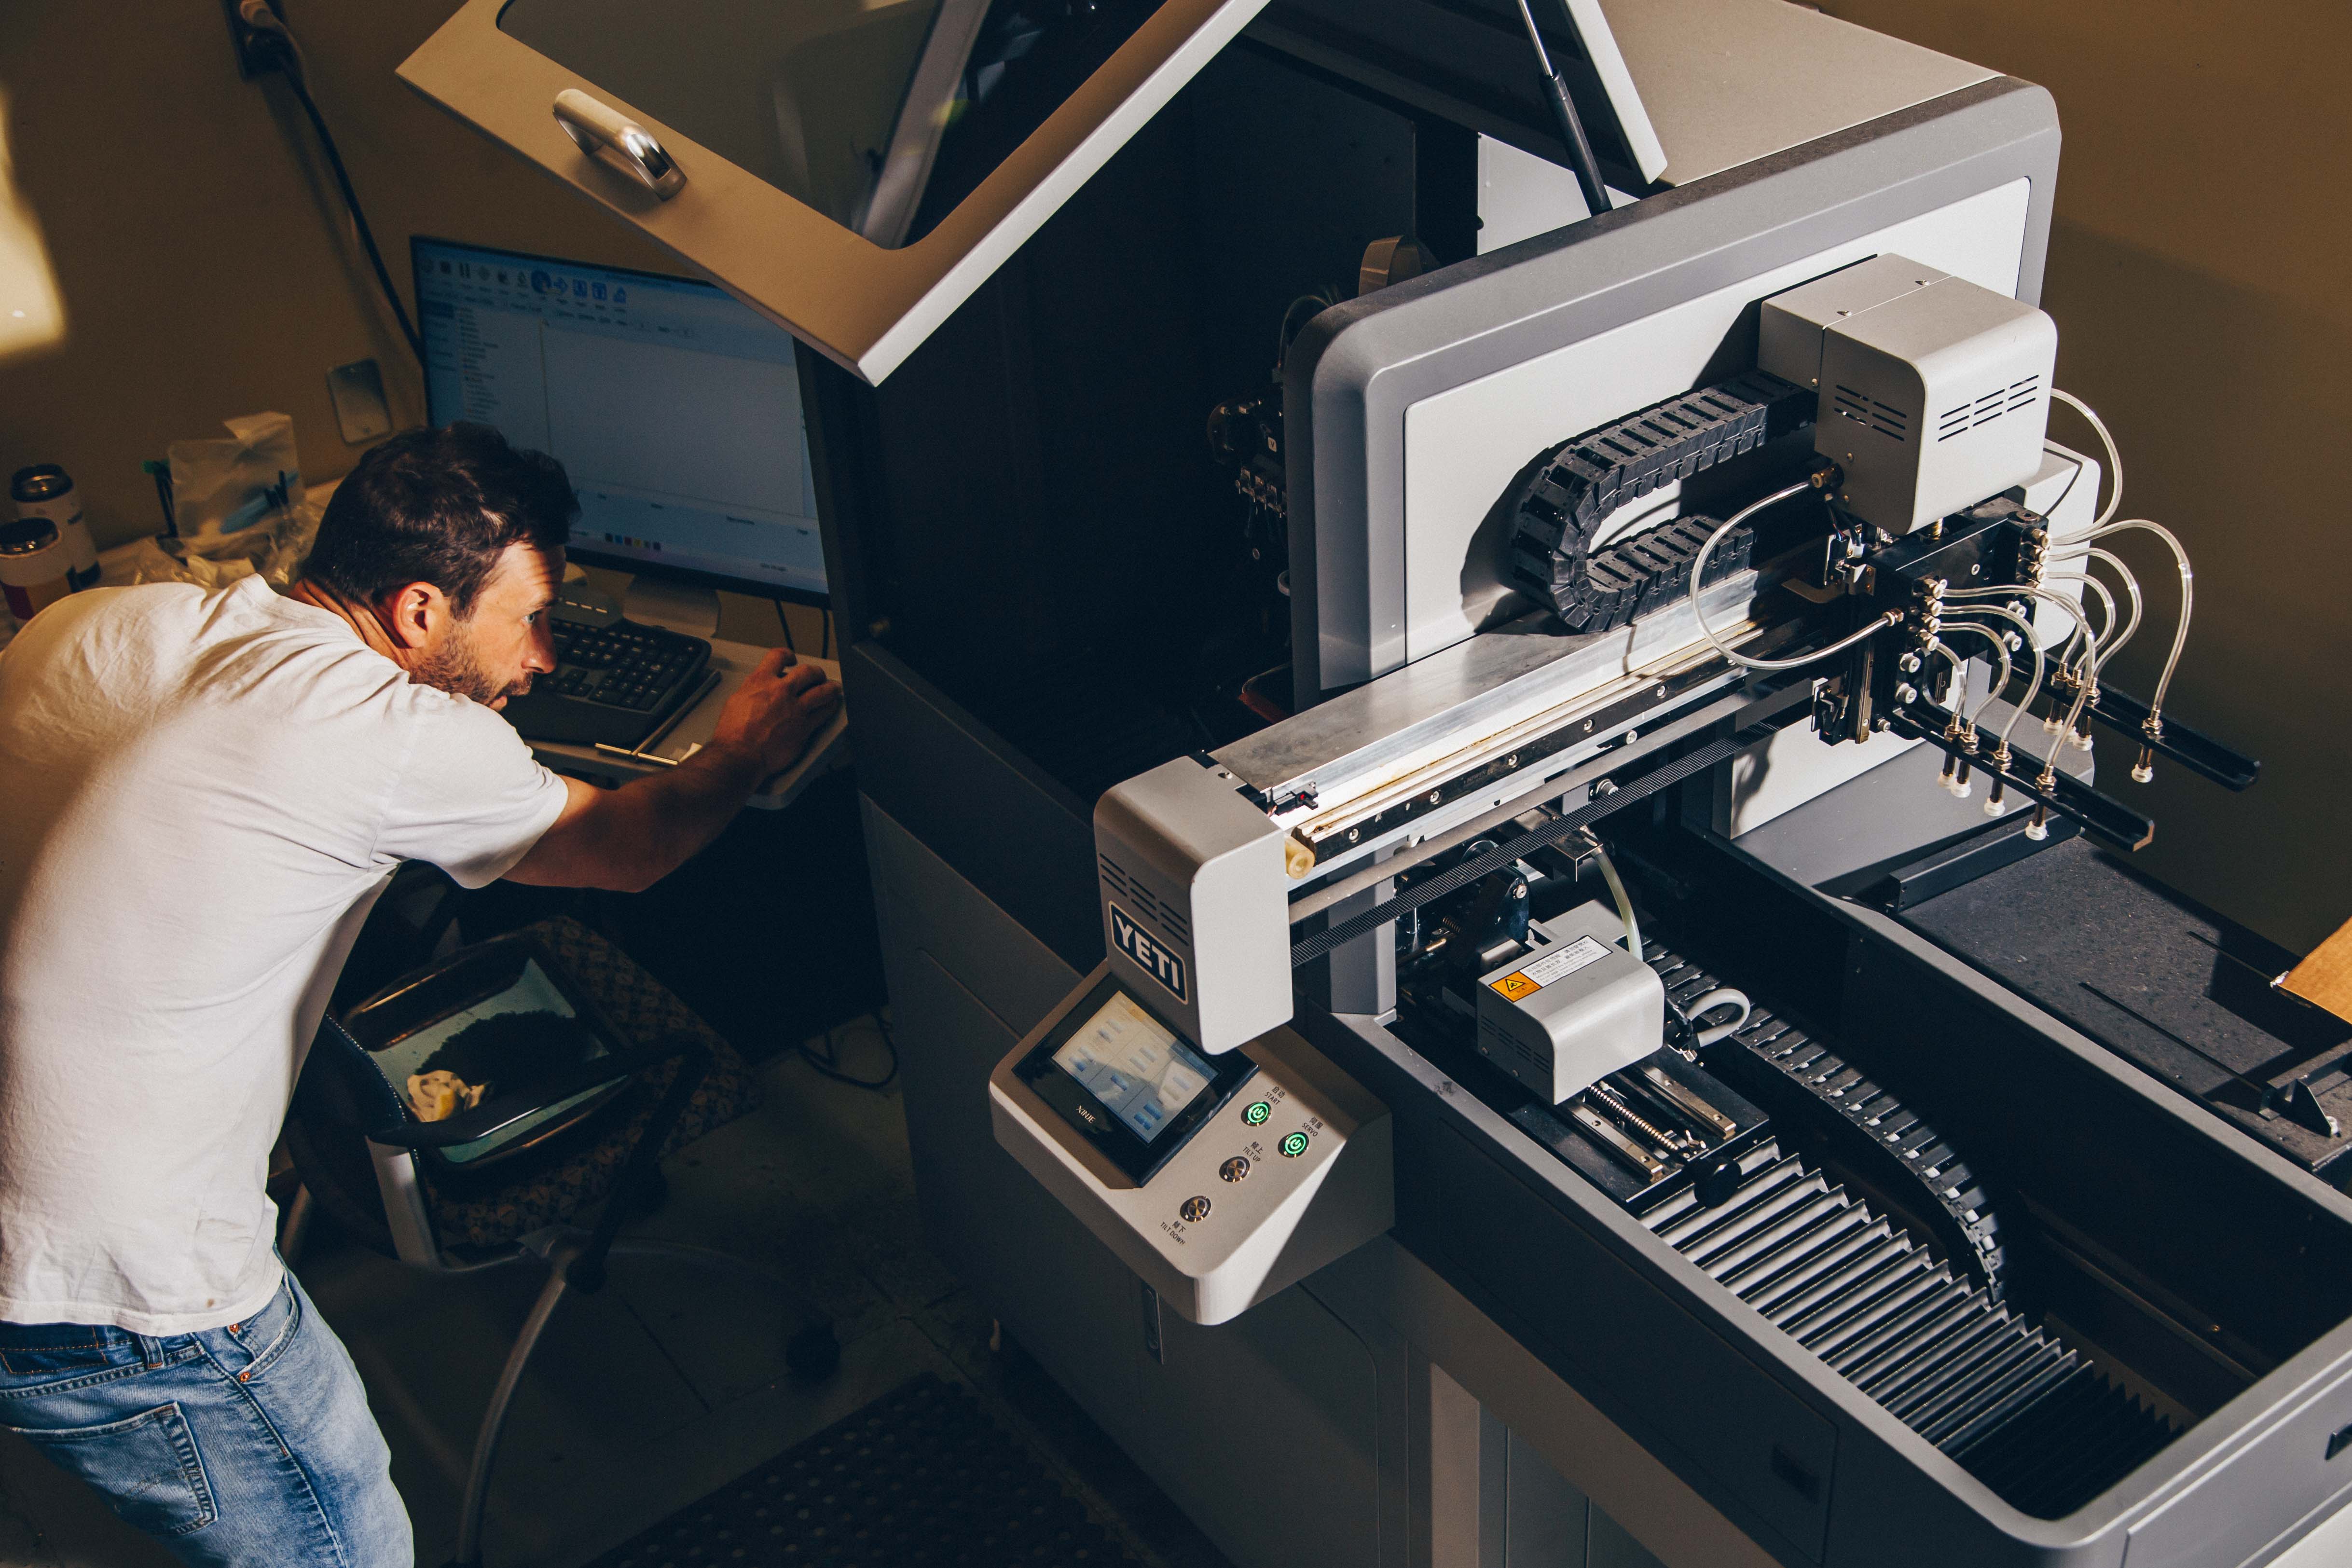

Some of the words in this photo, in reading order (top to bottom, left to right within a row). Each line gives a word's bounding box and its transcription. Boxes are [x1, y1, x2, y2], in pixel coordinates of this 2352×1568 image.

[1115, 914, 1179, 990] YETI
[1265, 1091, 1280, 1105] START
[1271, 1086, 1285, 1099] 启动
[1076, 1105, 1096, 1124] XINJE
[1302, 1122, 1318, 1137] SERVO
[1243, 1146, 1254, 1156] TILT
[1160, 1221, 1171, 1232] TILT
[1169, 1230, 1185, 1245] DOWN
